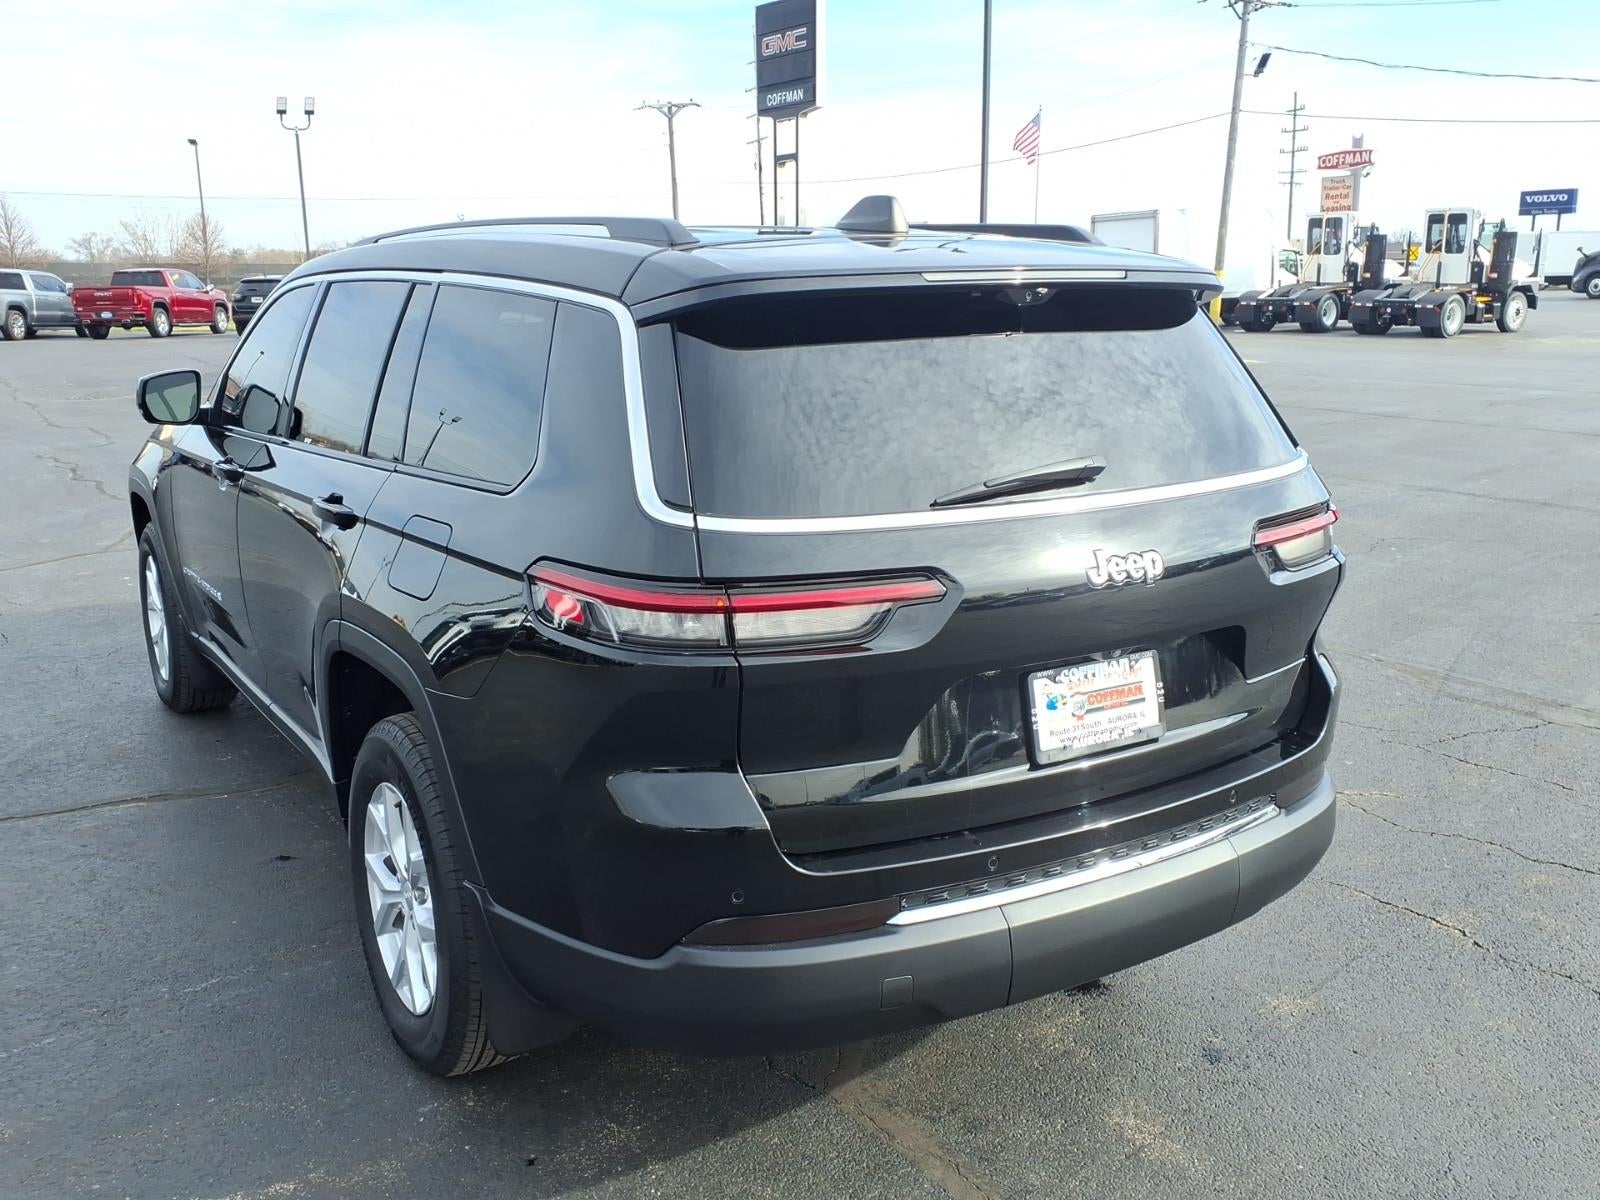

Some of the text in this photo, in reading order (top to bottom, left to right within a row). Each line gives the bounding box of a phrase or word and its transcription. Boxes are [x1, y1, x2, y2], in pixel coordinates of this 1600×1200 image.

[762, 27, 807, 56] GMC
[766, 88, 804, 106] COFFMAN
[1320, 151, 1370, 167] COFFMAN
[1324, 192, 1350, 200] Rental
[1525, 193, 1568, 203] VOLVO
[1085, 549, 1164, 588] Jeep
[1060, 658, 1130, 682] COFFMAN
[1087, 684, 1144, 706] COFFMAN
[1049, 728, 1071, 737] Route
[1072, 724, 1080, 732] 31
[1080, 720, 1102, 730] South
